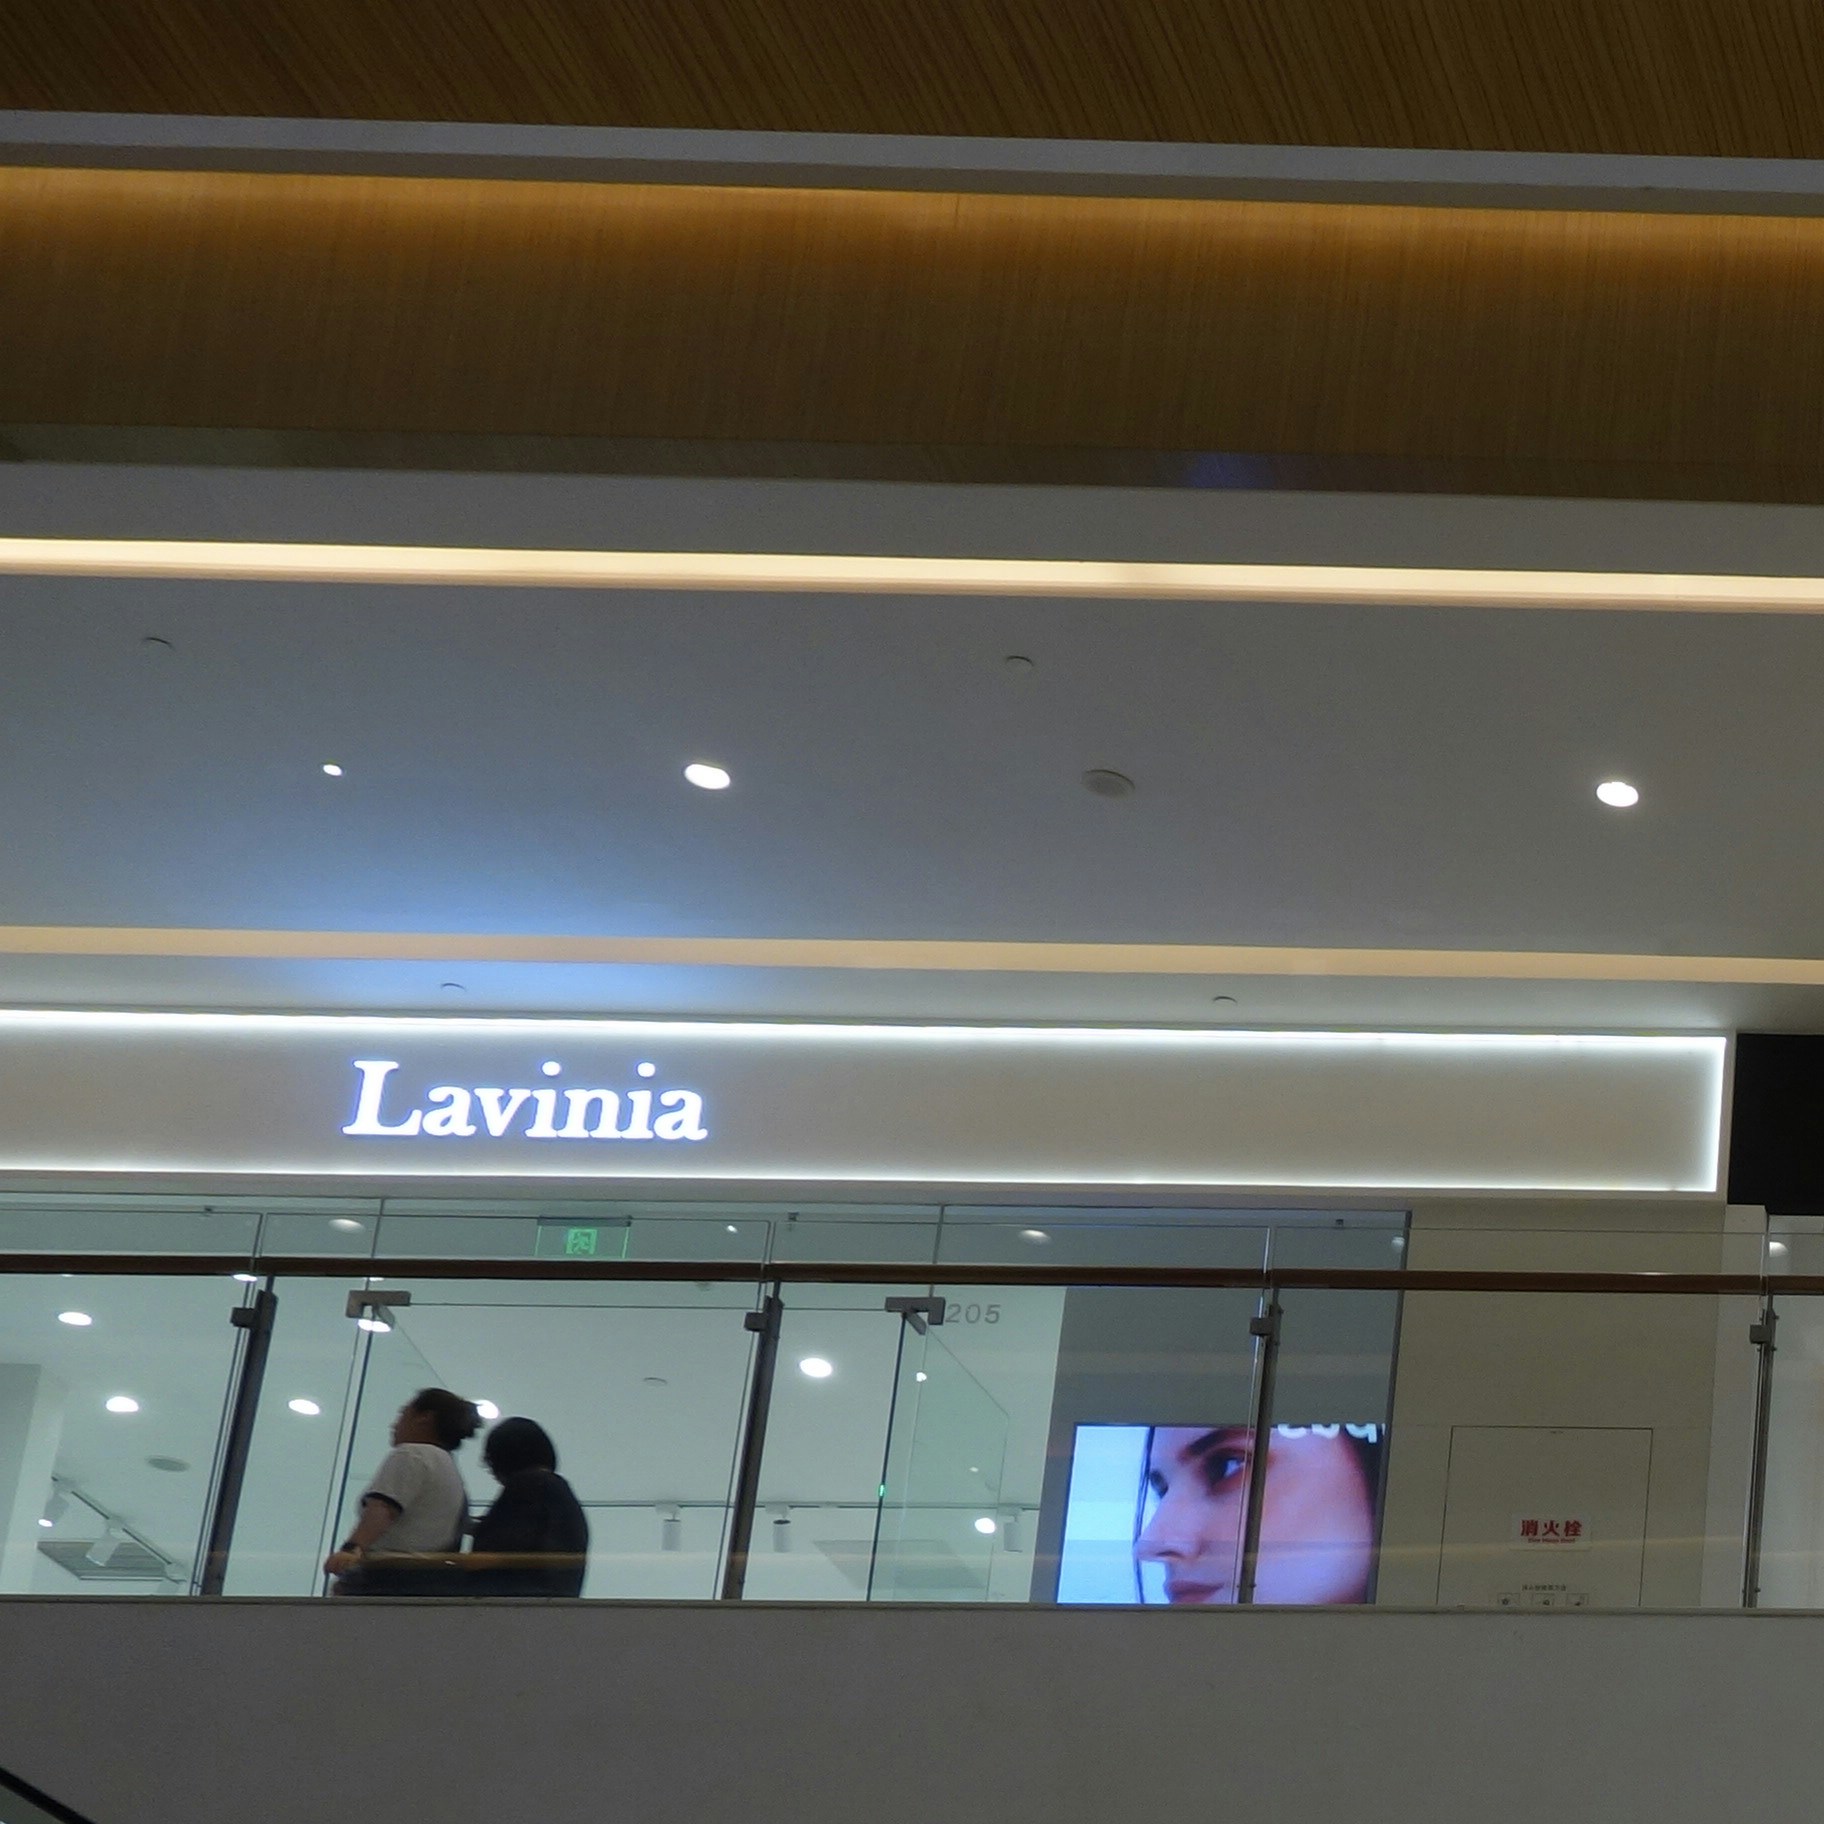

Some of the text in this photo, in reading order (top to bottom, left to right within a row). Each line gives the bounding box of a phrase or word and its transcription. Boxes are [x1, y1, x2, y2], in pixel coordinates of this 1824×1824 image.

[341, 1057, 710, 1143] Lavinia
[946, 1303, 1001, 1325] 205
[1520, 1519, 1582, 1537] 消火栓
